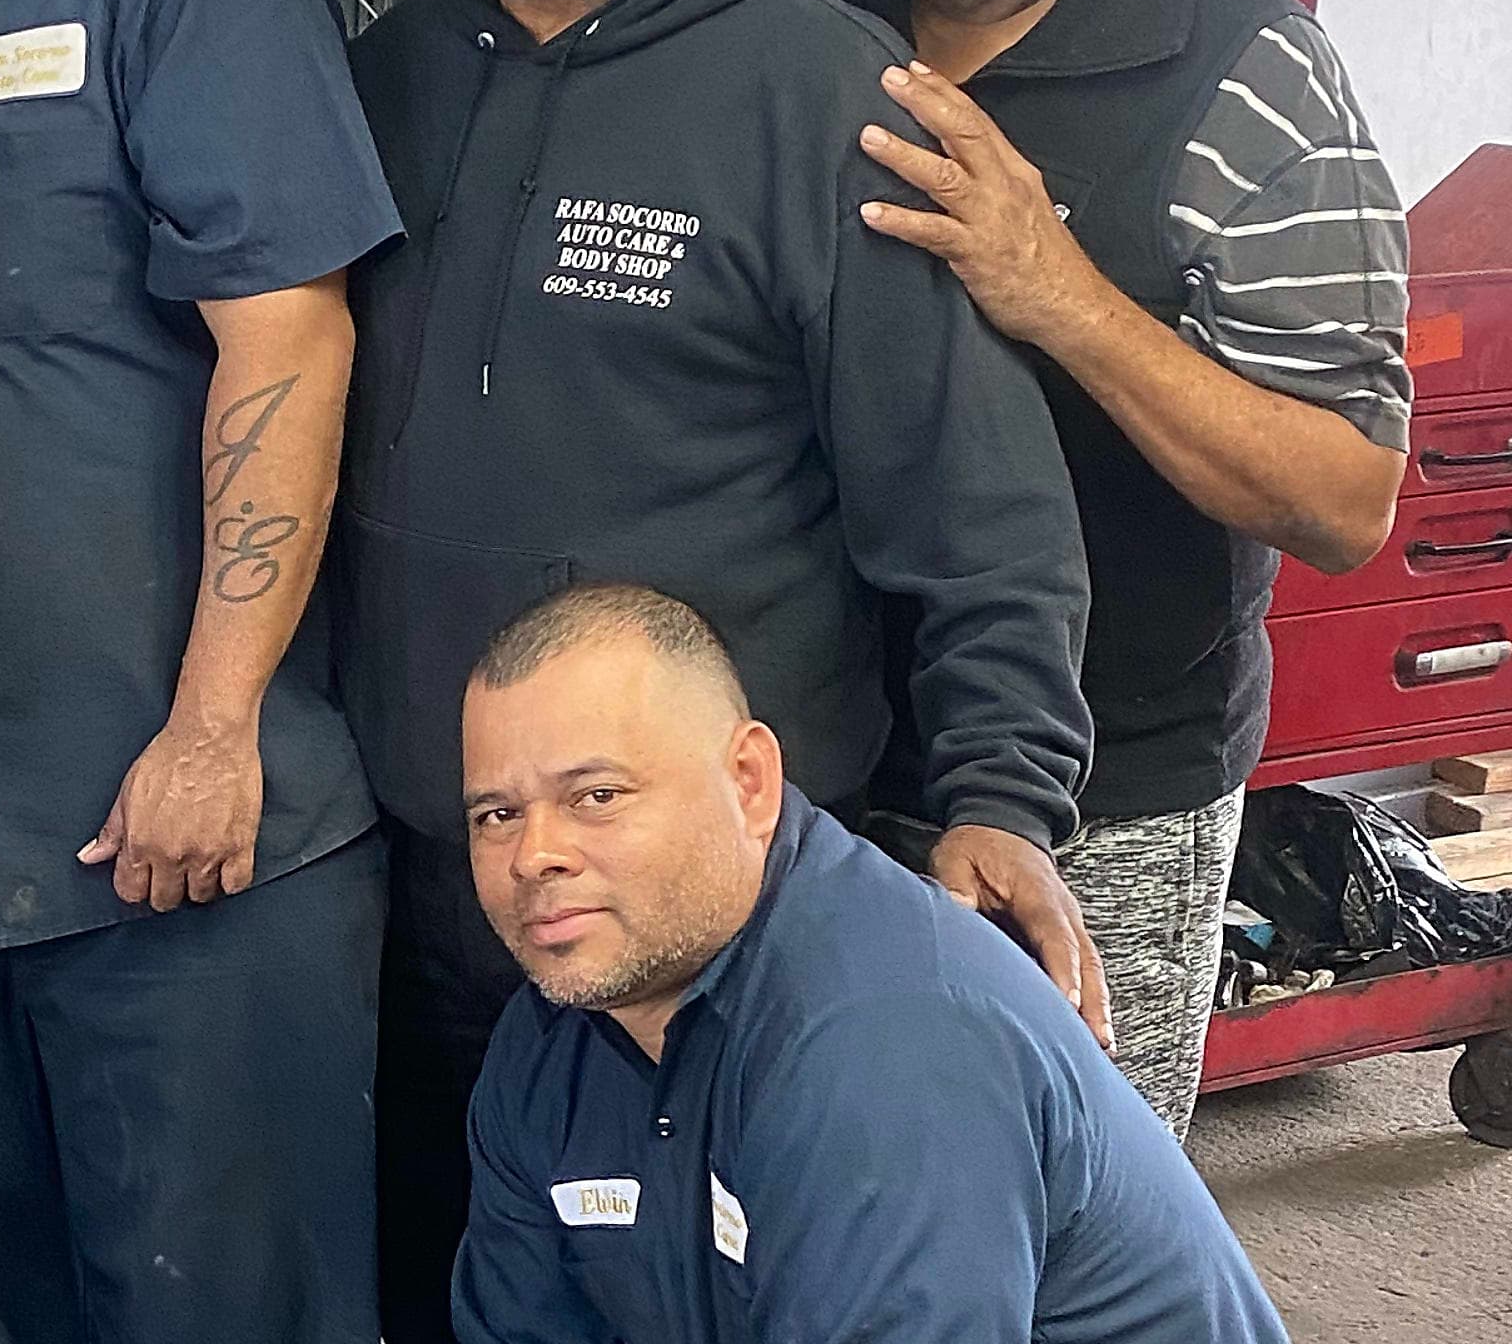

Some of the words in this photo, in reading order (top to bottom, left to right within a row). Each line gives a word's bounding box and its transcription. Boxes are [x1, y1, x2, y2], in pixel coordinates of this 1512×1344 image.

[555, 198, 605, 221] RAFA
[606, 202, 701, 237] SOCORRO
[556, 223, 614, 246] AUTO
[614, 228, 672, 255] CARE
[670, 242, 686, 259] &
[558, 247, 617, 272] BODY
[614, 253, 672, 280] SHOP
[542, 274, 673, 309] 609-553-4545
